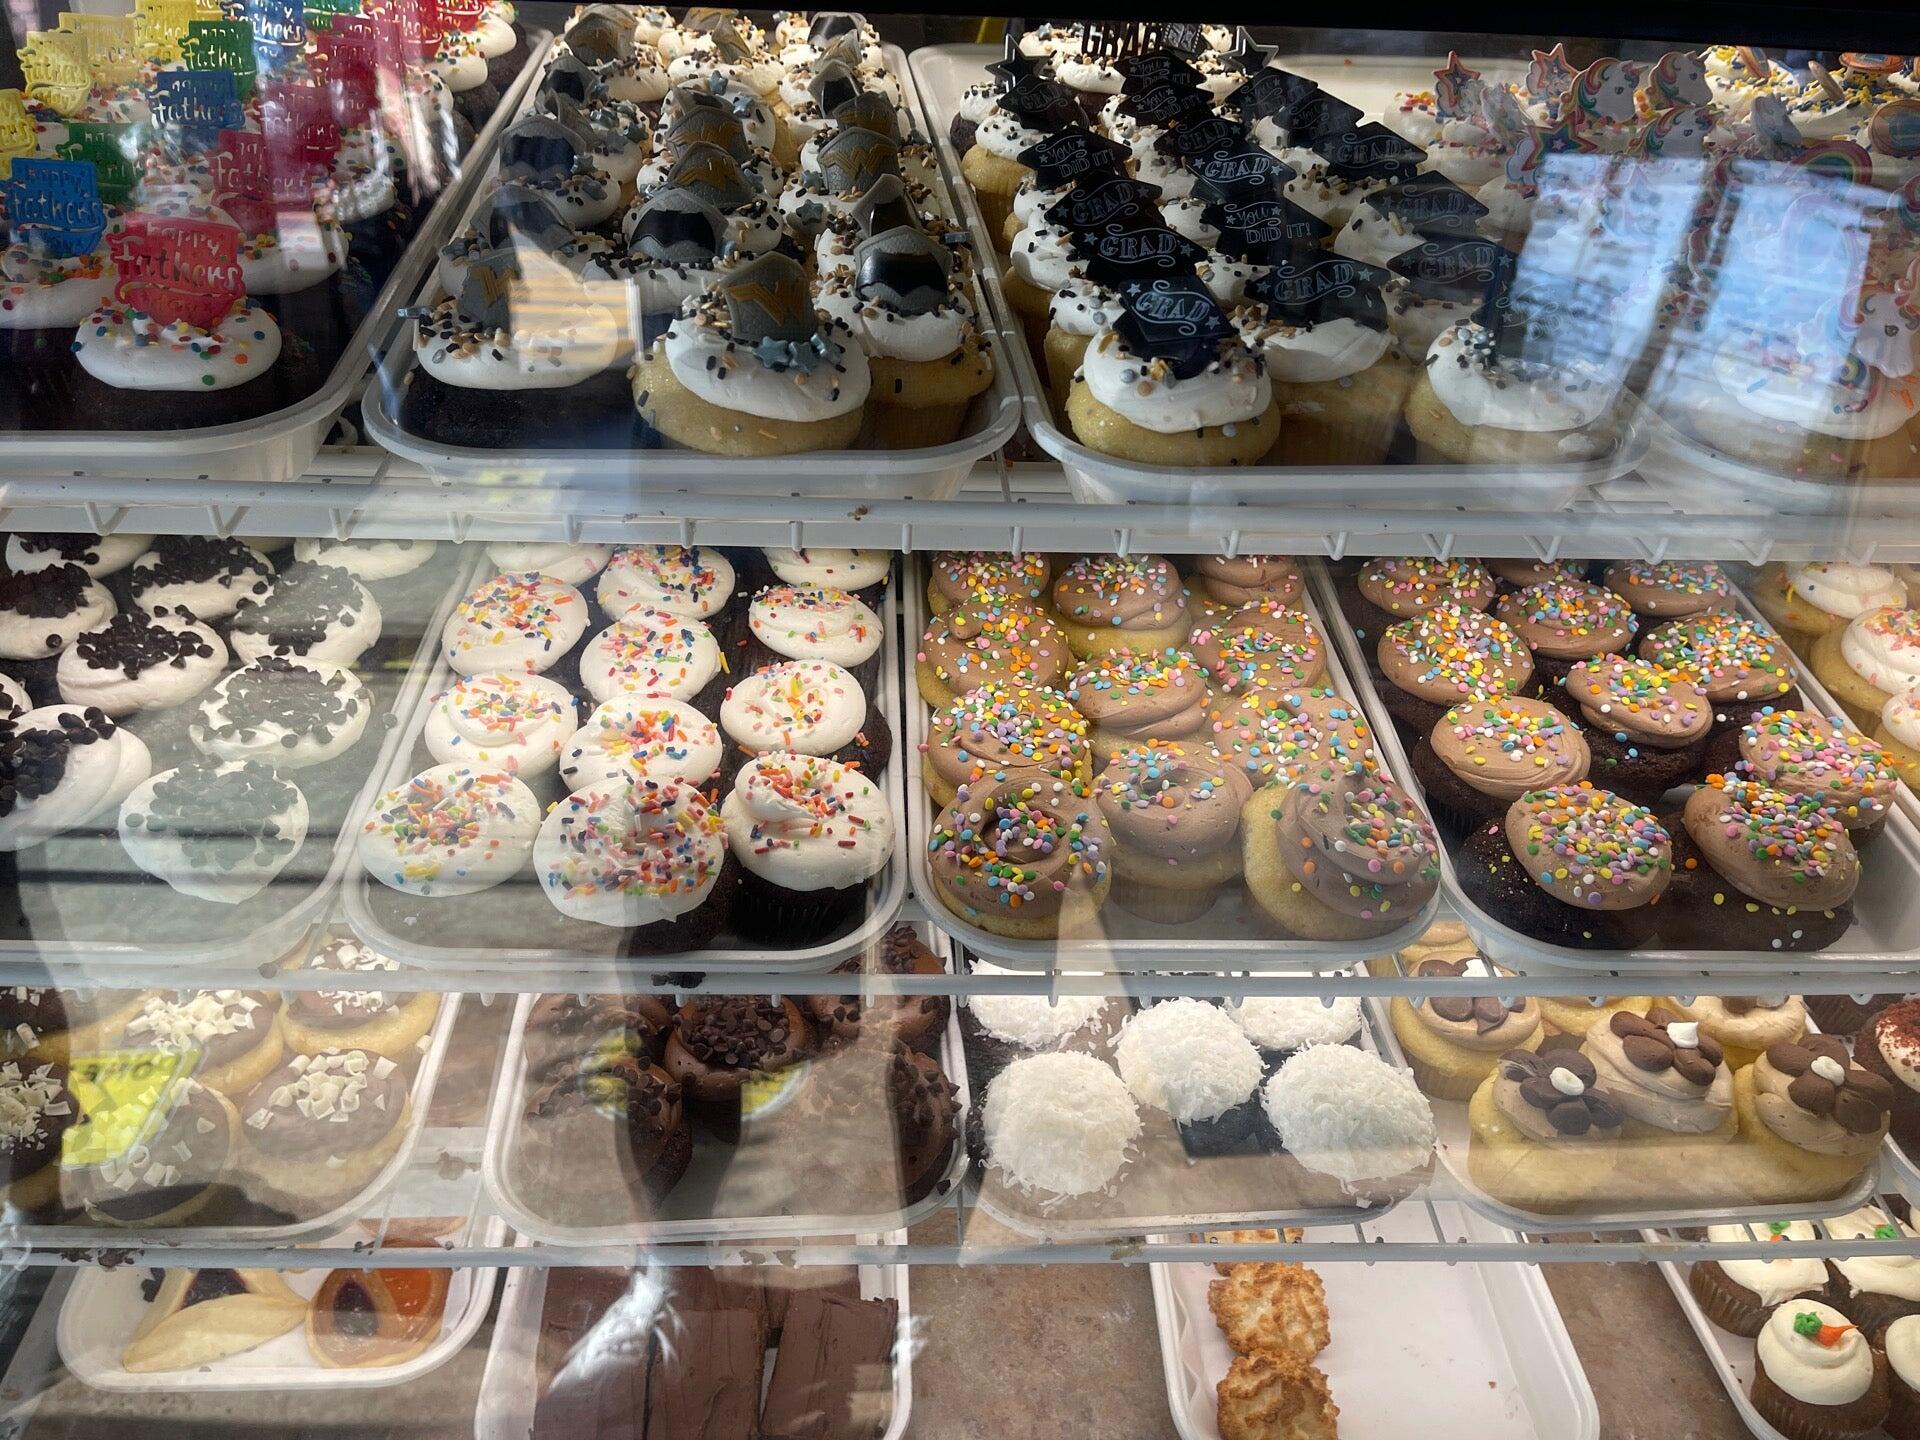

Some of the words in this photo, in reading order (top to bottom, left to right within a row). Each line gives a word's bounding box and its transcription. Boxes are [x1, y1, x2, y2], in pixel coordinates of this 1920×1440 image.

[1178, 121, 1229, 150] GRAD
[1336, 139, 1401, 164] GRAD
[1058, 157, 1090, 178] DID
[1204, 157, 1270, 179] GRAD
[1072, 182, 1135, 223] GRAD
[1100, 233, 1177, 259] GRAD
[1246, 226, 1282, 244] DID
[1286, 222, 1312, 239] IT!
[1418, 246, 1496, 280] GRAD
[1274, 263, 1354, 301] GRAD
[1135, 291, 1210, 322] GRAD
